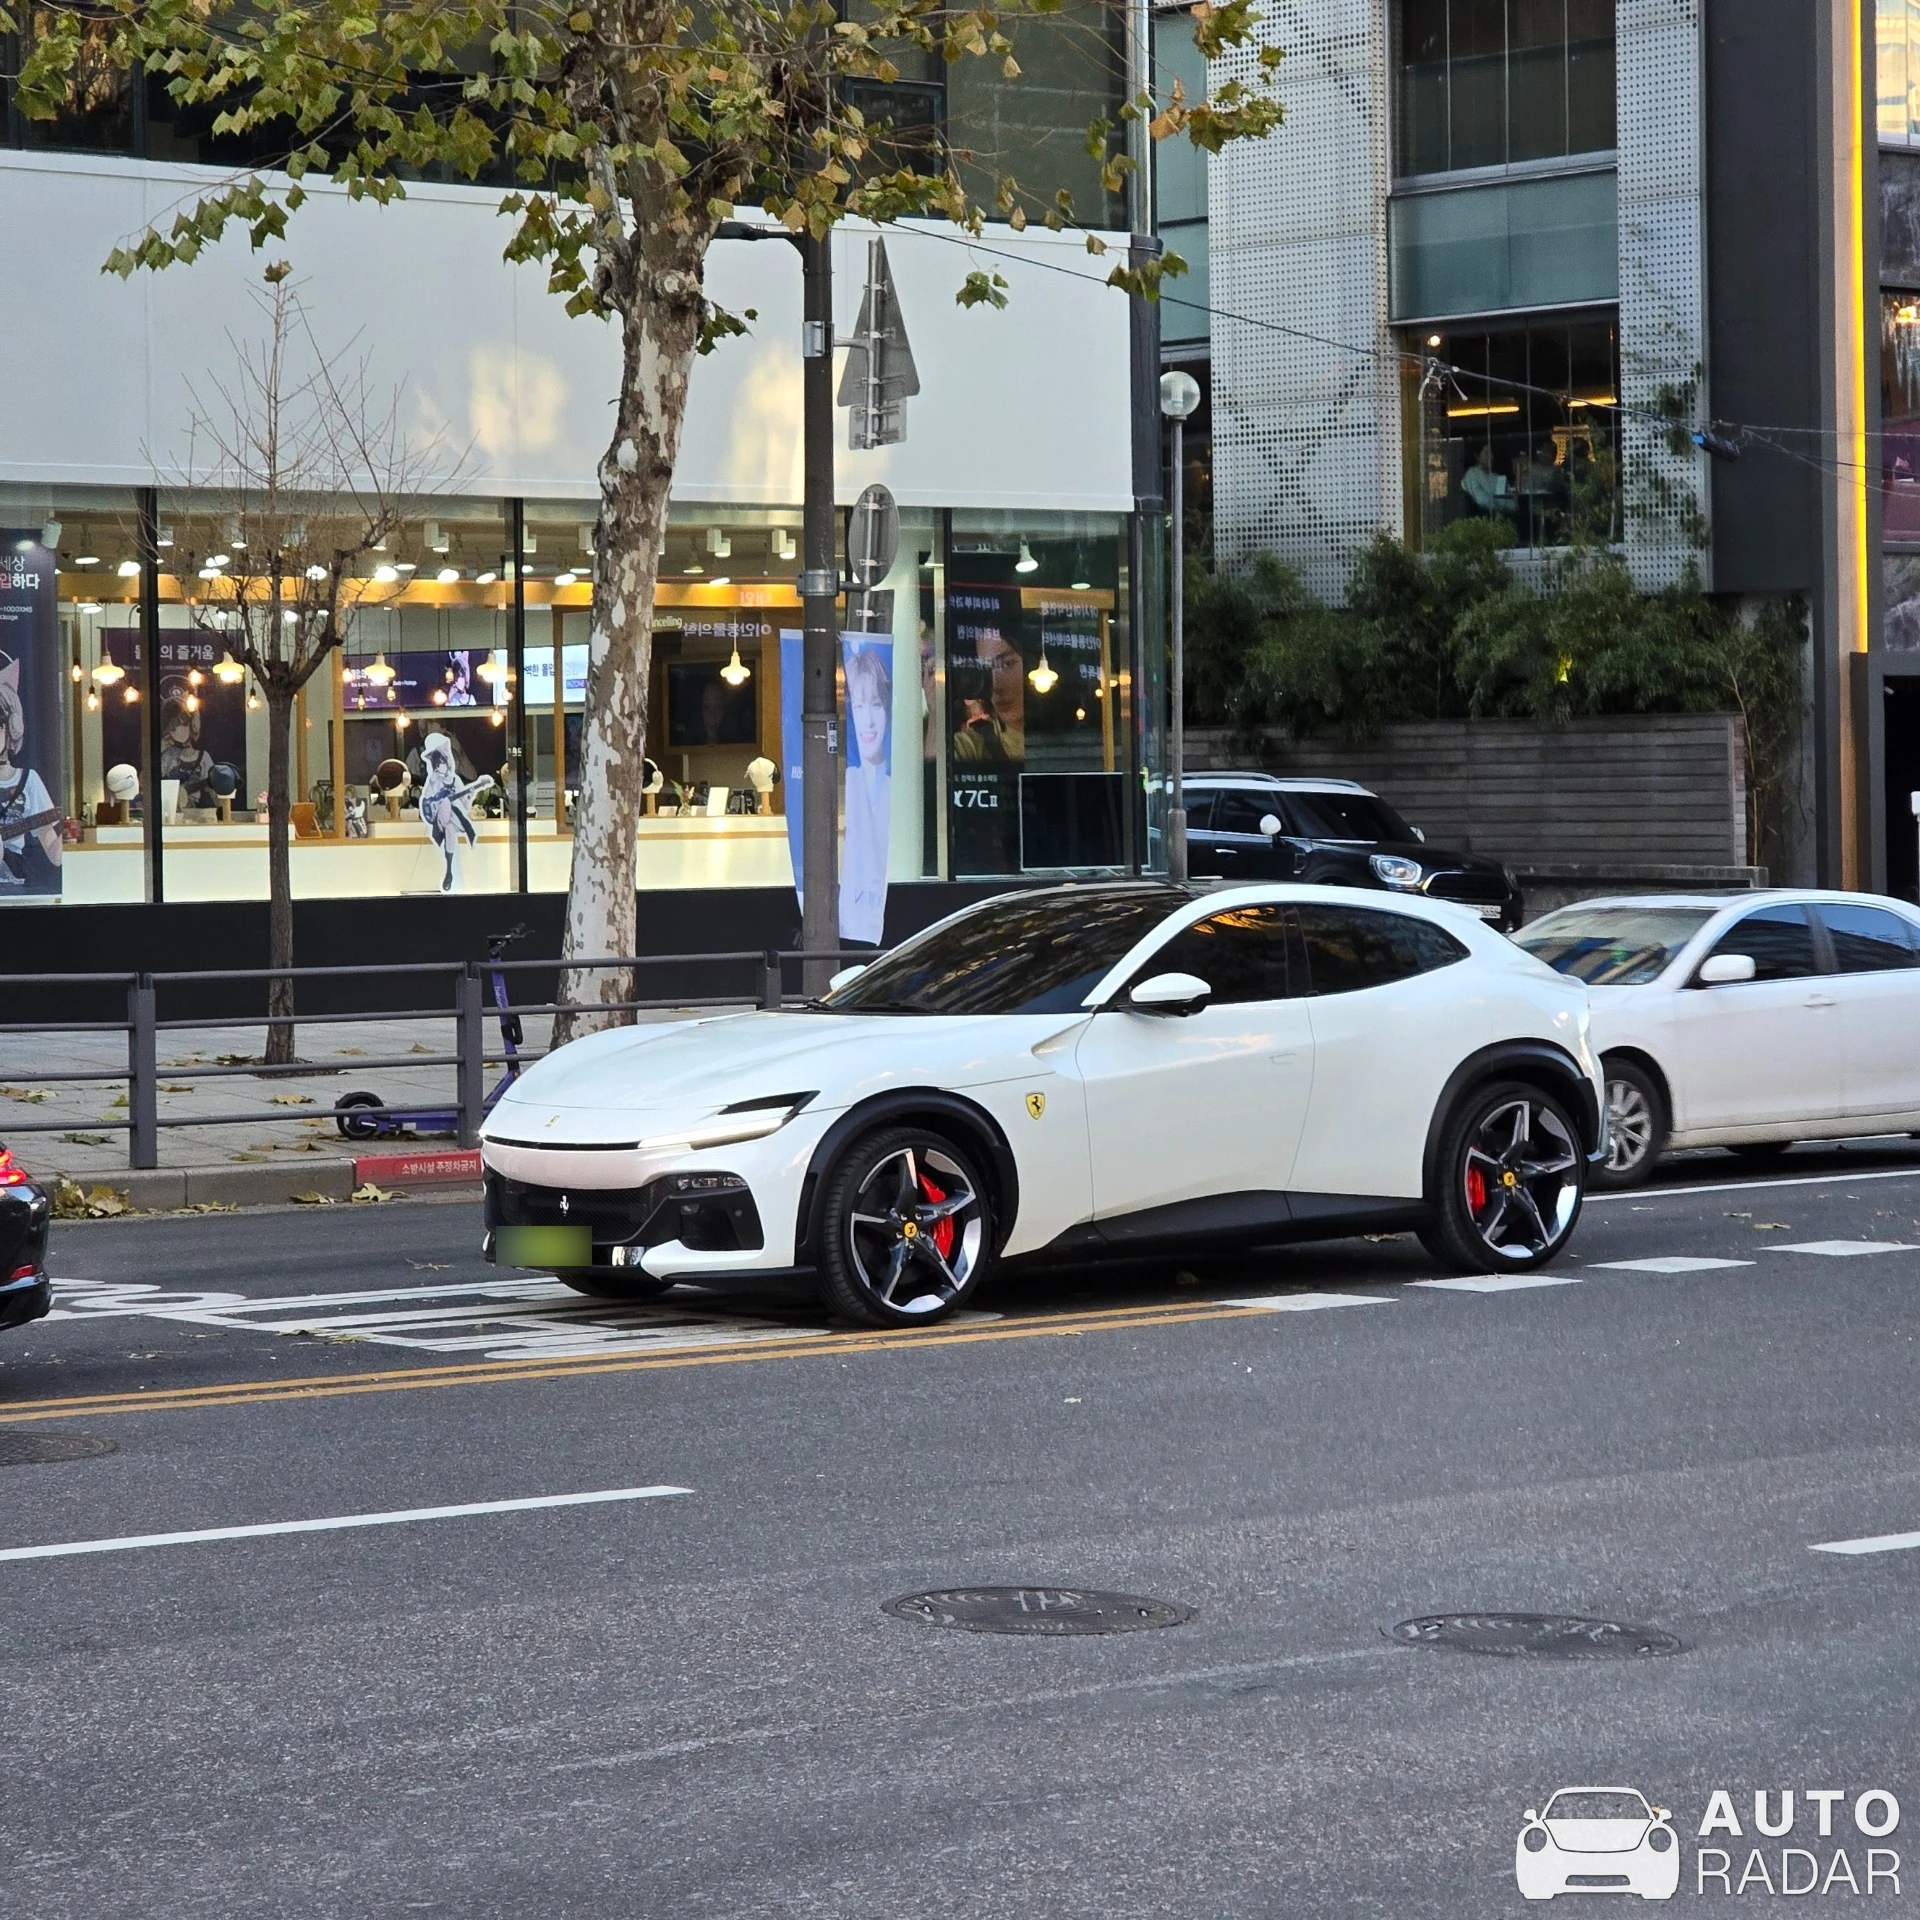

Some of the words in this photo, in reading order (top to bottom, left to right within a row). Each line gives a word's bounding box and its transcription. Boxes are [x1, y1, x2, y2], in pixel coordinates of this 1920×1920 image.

[177, 644, 215, 661] 즐거움
[401, 1163, 435, 1176] 소방시설
[436, 1159, 478, 1174] 주정차금지
